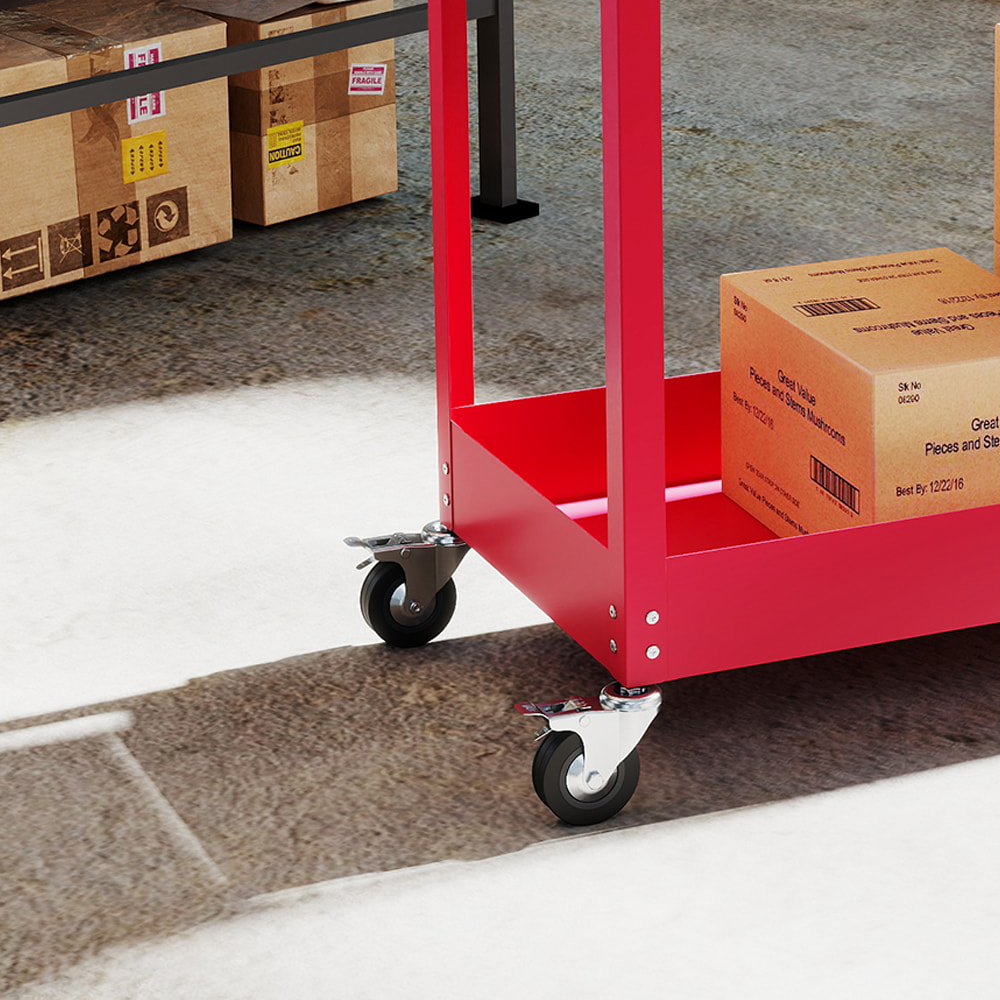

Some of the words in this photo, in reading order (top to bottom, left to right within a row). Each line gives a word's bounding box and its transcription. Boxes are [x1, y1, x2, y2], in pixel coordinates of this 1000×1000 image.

[351, 77, 382, 85] FRAGILE
[268, 145, 301, 163] CAUTION
[971, 416, 1000, 431] Great
[925, 442, 959, 457] Pieces
[961, 436, 981, 452] and
[895, 485, 914, 497] Best
[929, 477, 965, 493] 12/22/16
